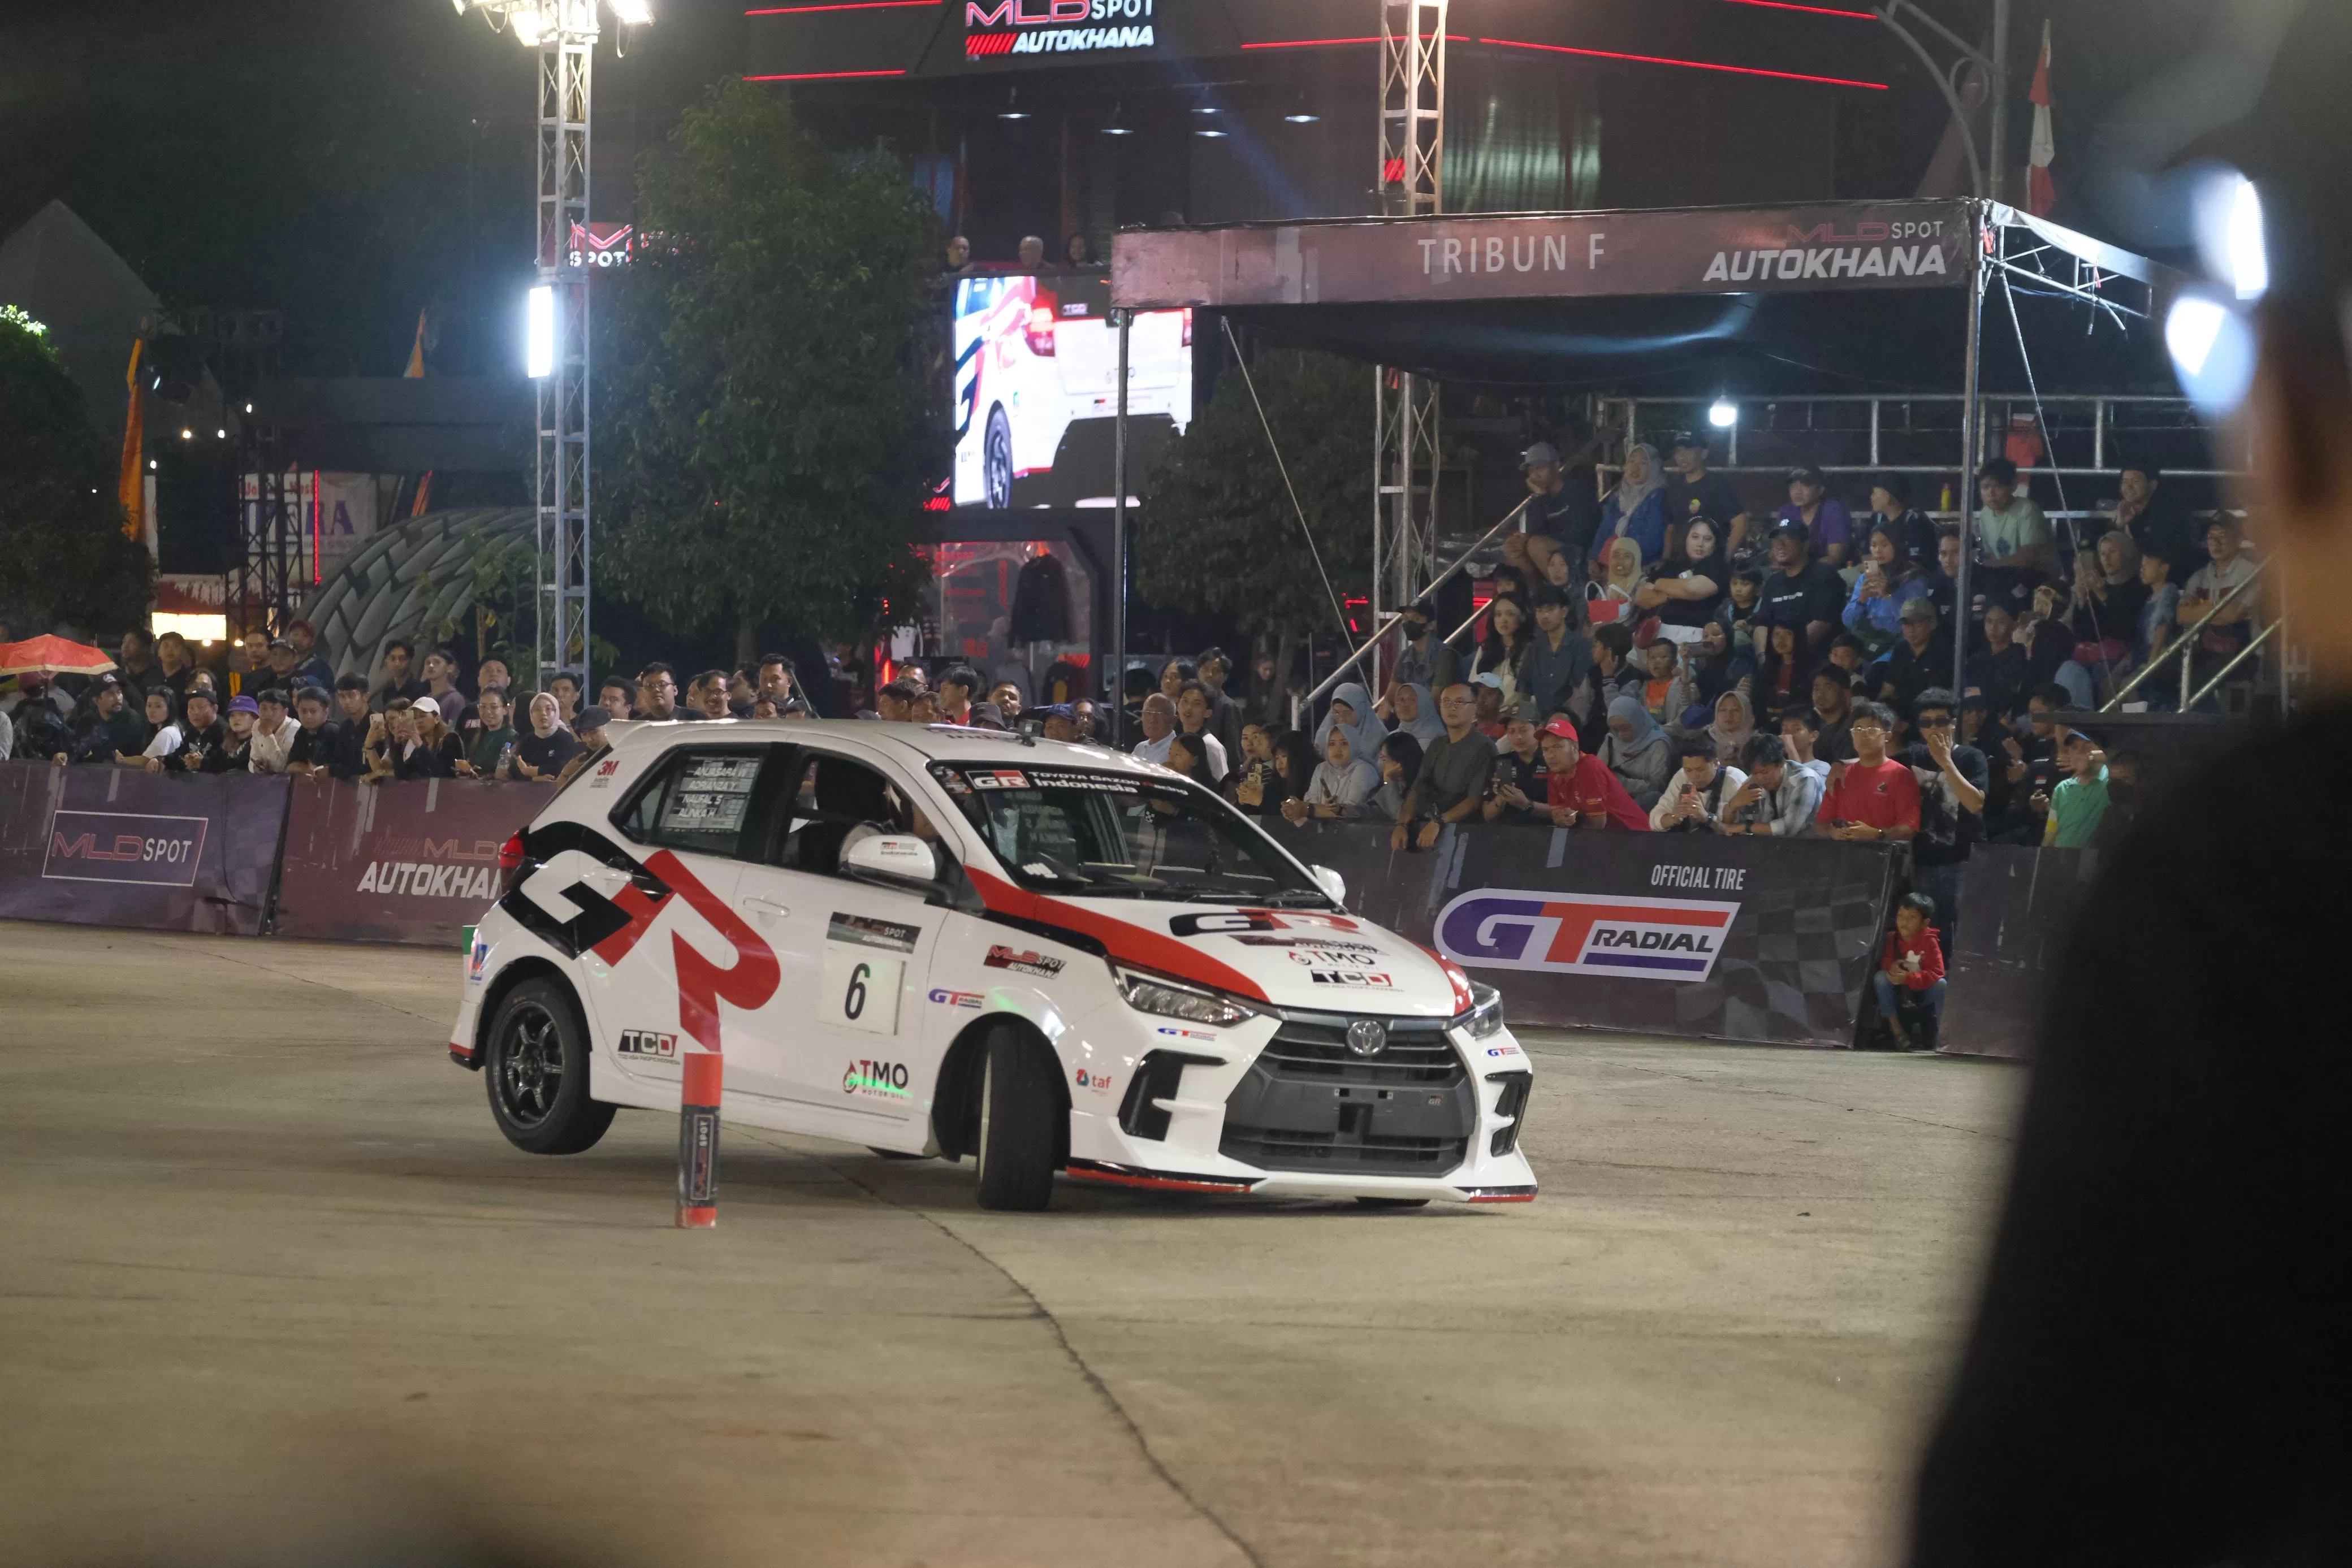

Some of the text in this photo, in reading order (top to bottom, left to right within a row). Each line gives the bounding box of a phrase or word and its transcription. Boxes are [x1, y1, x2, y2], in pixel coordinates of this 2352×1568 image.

[966, 0, 1152, 26] MLDSPOT
[1011, 25, 1155, 54] AUTOKHANA
[1786, 220, 1944, 243] MLDSPOT
[1417, 233, 1605, 274] TRIBUN F
[1703, 244, 1947, 281] AUTOKHANA
[597, 760, 620, 776] 3M
[1028, 771, 1088, 780] TOYOTA
[1089, 775, 1140, 786] GAZOO
[974, 776, 1024, 787] GR
[1034, 778, 1138, 794] Indonesia
[51, 831, 192, 863] MLDSPOT
[356, 861, 503, 900] AUTOKHAN
[1651, 864, 1746, 890] OFFICIAL TIRE
[1169, 908, 1368, 937] GR
[499, 821, 780, 1051] GR
[1591, 929, 1714, 953] RADIAL
[1305, 950, 1376, 965] TMO
[1311, 969, 1393, 986] TCD
[845, 963, 870, 1020] 6
[622, 1030, 675, 1056] TCD
[859, 1059, 909, 1089] TMO
[1092, 1076, 1112, 1090] taf
